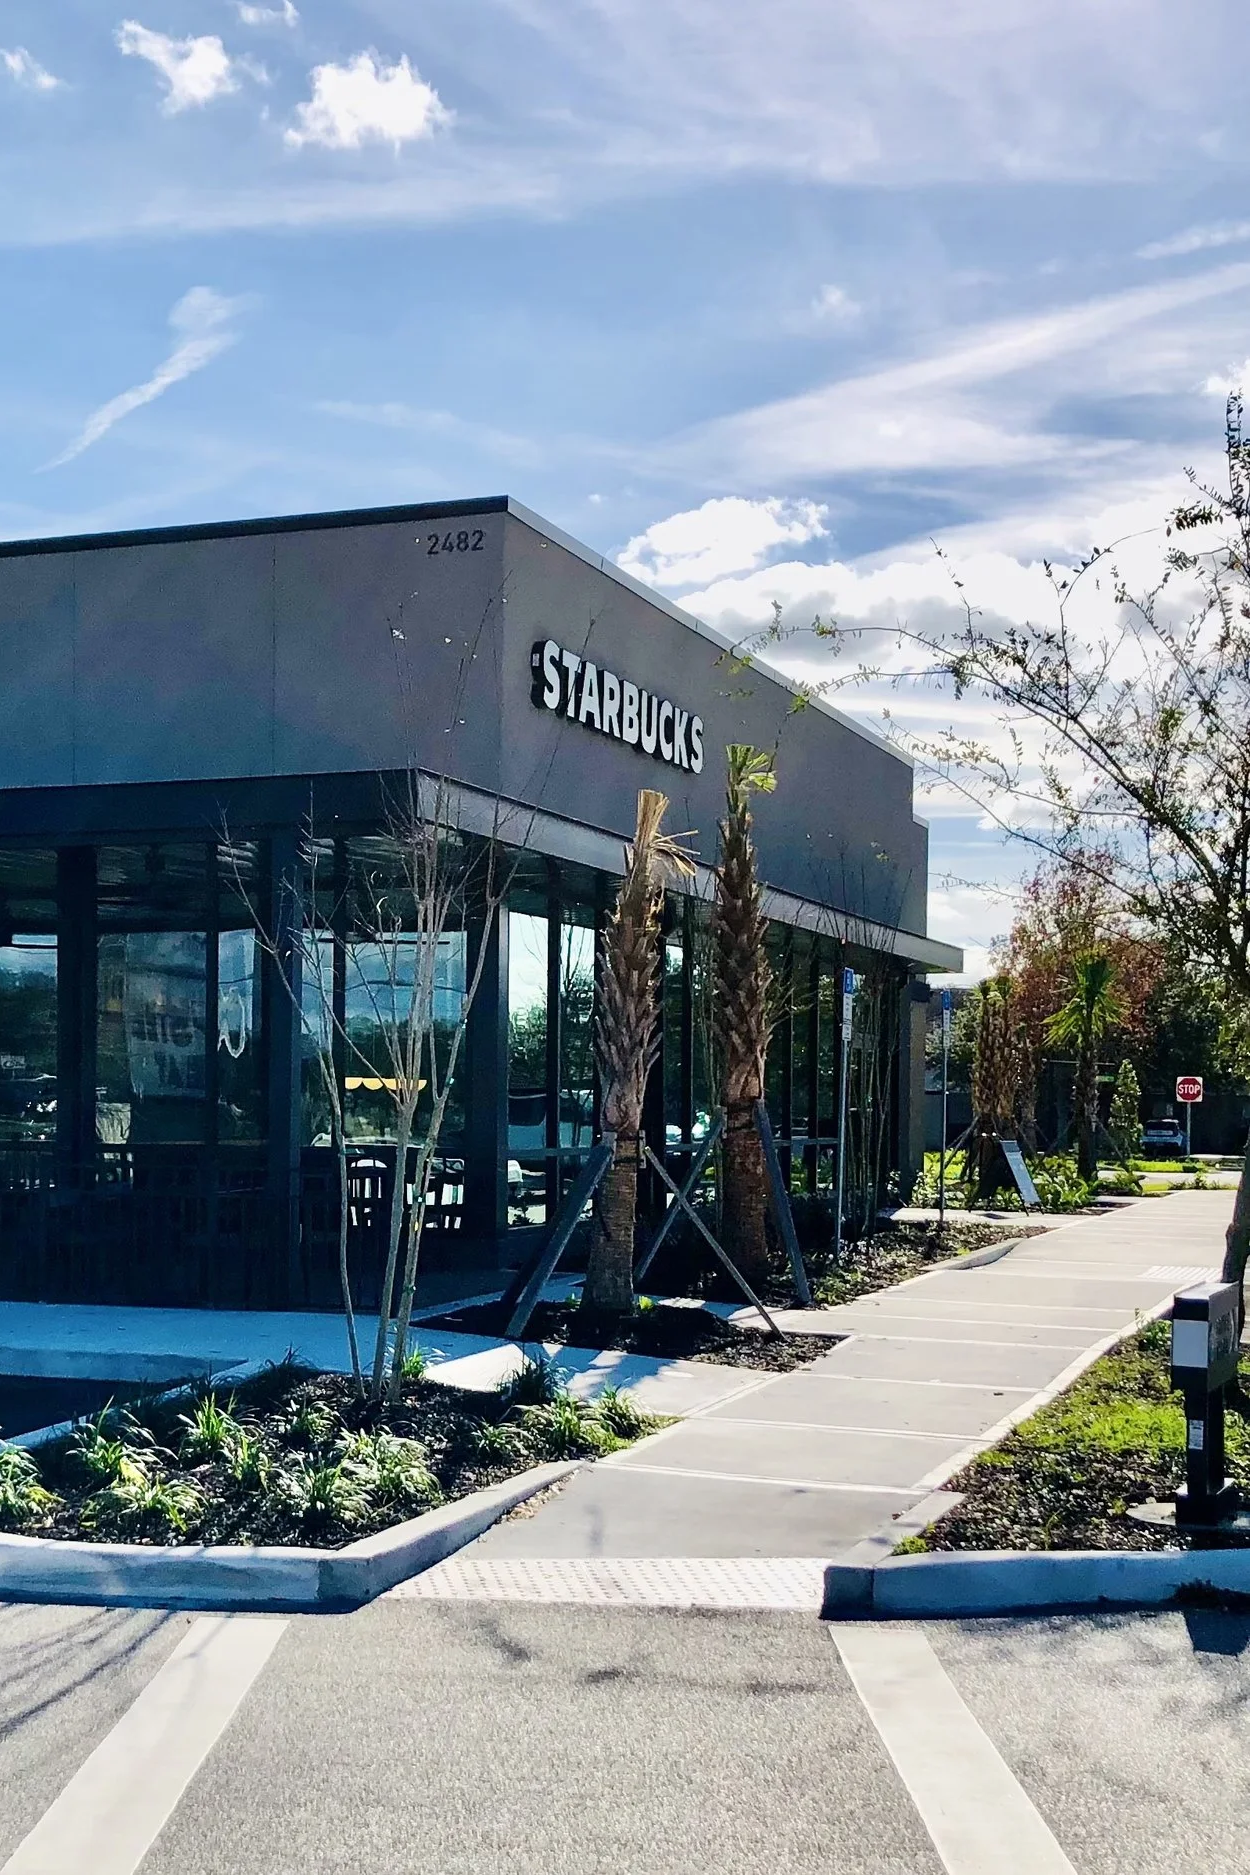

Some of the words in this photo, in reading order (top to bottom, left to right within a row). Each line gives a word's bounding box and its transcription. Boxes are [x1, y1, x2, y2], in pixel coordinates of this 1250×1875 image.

[427, 529, 484, 555] 2482
[543, 640, 704, 774] STARBUCKS
[1178, 1084, 1200, 1095] STOP
